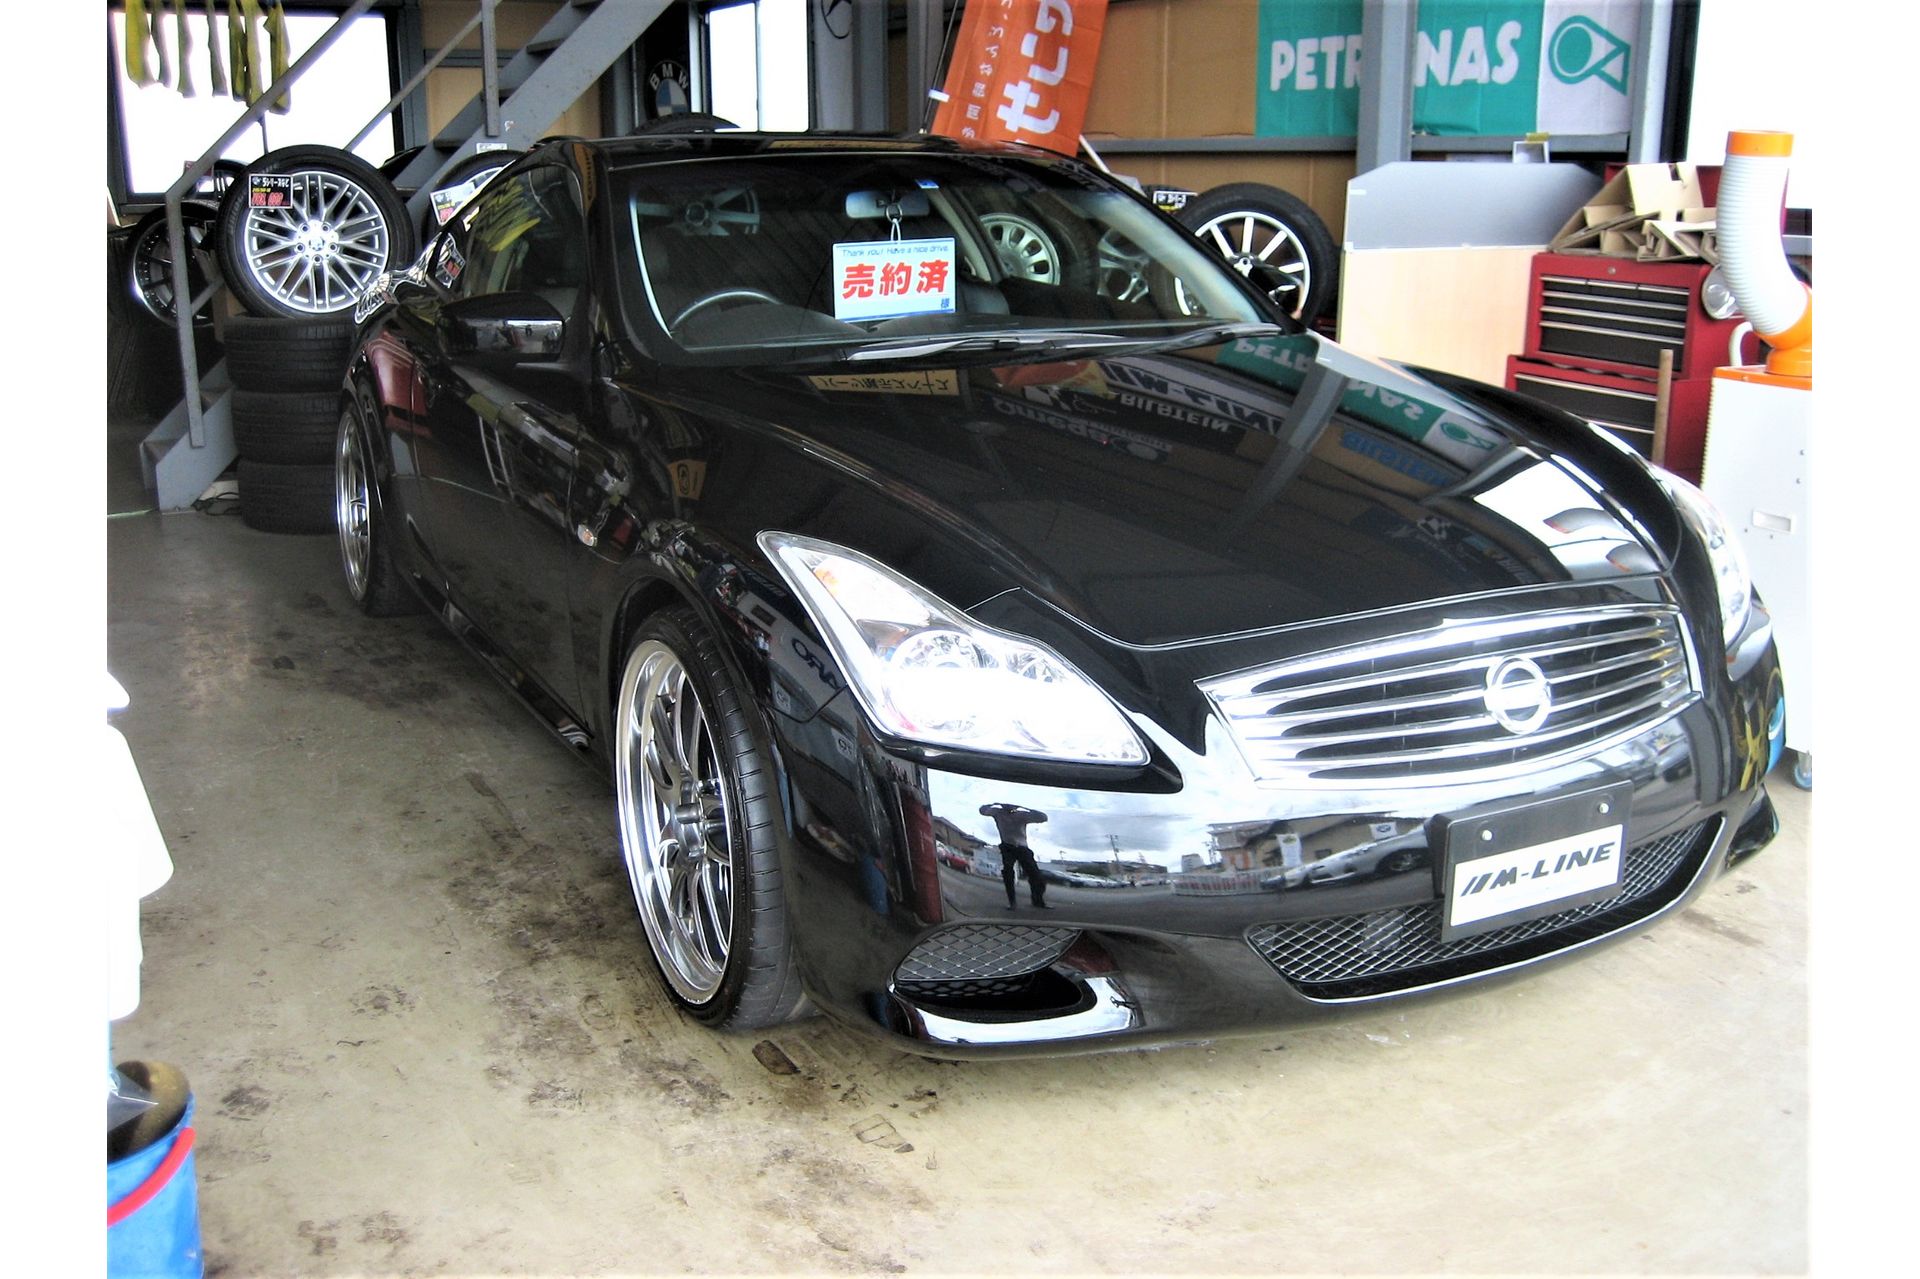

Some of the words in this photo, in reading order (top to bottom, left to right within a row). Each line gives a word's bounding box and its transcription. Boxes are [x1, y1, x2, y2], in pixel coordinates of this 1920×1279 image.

[1270, 20, 1522, 91] PETRNAS
[649, 63, 689, 91] BMW
[843, 249, 864, 257] Thank
[887, 247, 905, 255] Have
[842, 259, 949, 299] 売約済
